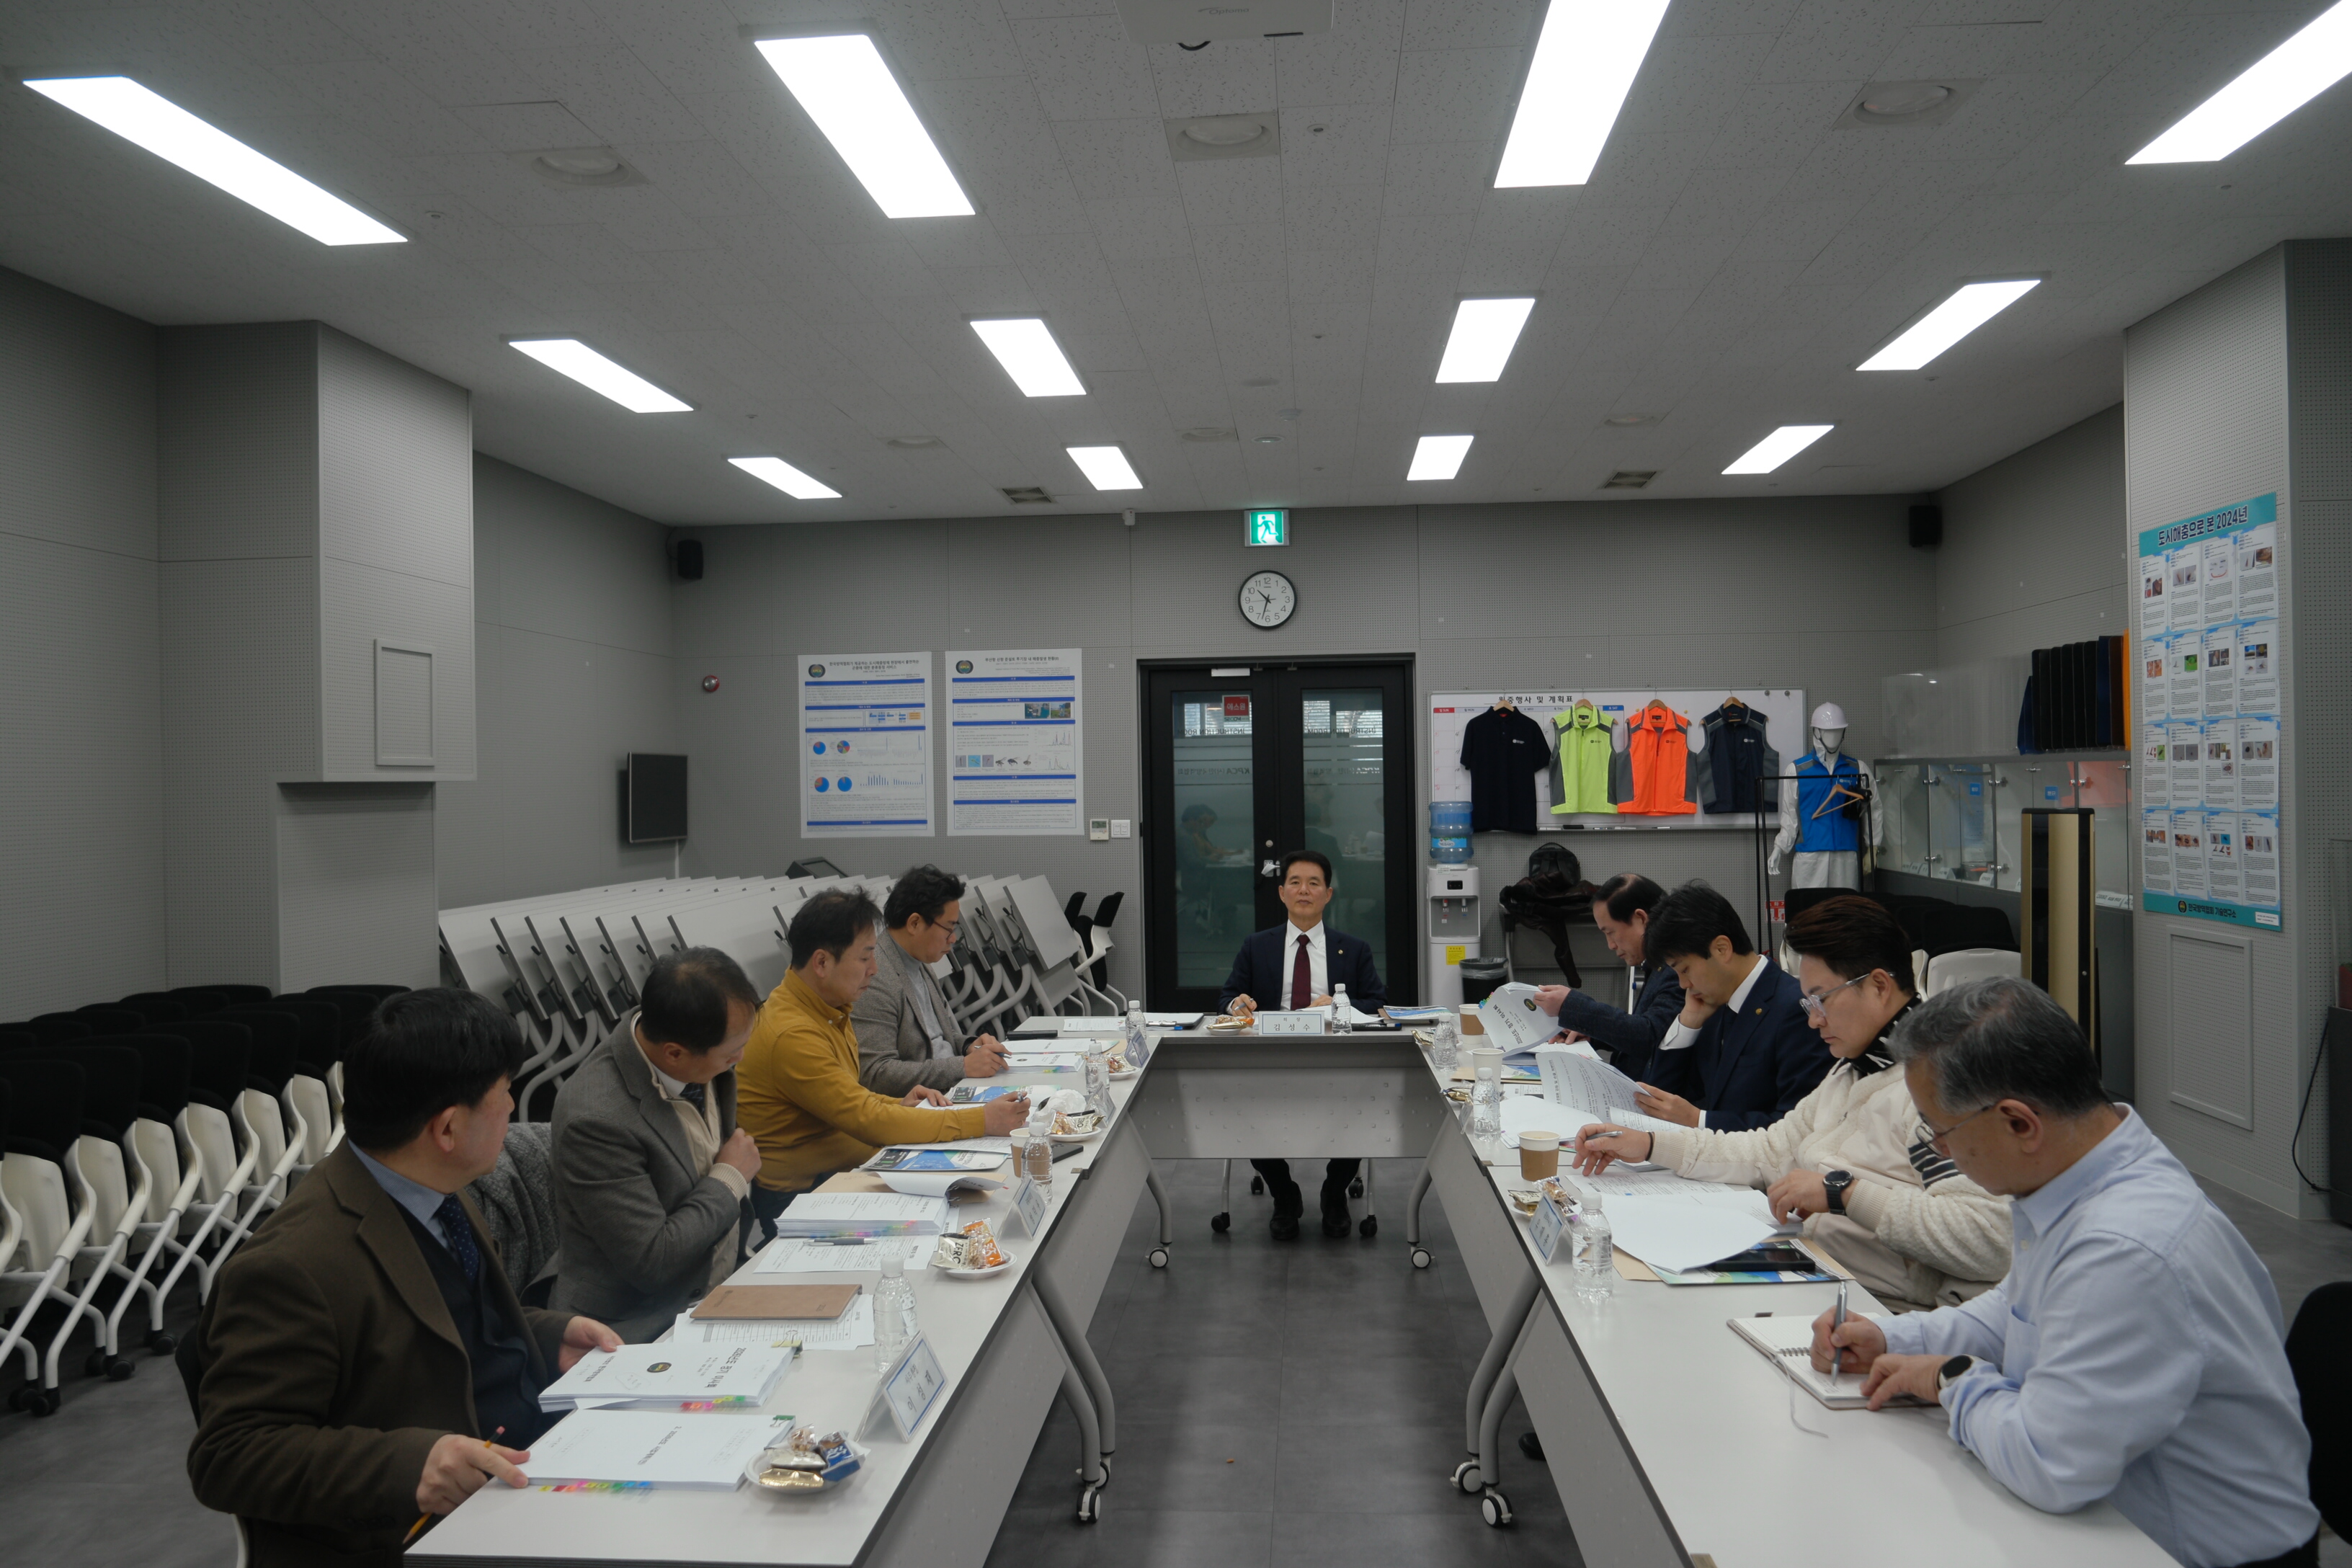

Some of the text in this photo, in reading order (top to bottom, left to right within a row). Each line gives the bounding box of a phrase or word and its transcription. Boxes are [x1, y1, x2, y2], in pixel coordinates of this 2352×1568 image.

[2157, 504, 2248, 547] 도시해충으로 본 2024년
[1549, 695, 1573, 704] 계획표
[2188, 903, 2214, 915] 한국방역협회
[907, 1396, 917, 1412] 이
[917, 1382, 926, 1401] 성
